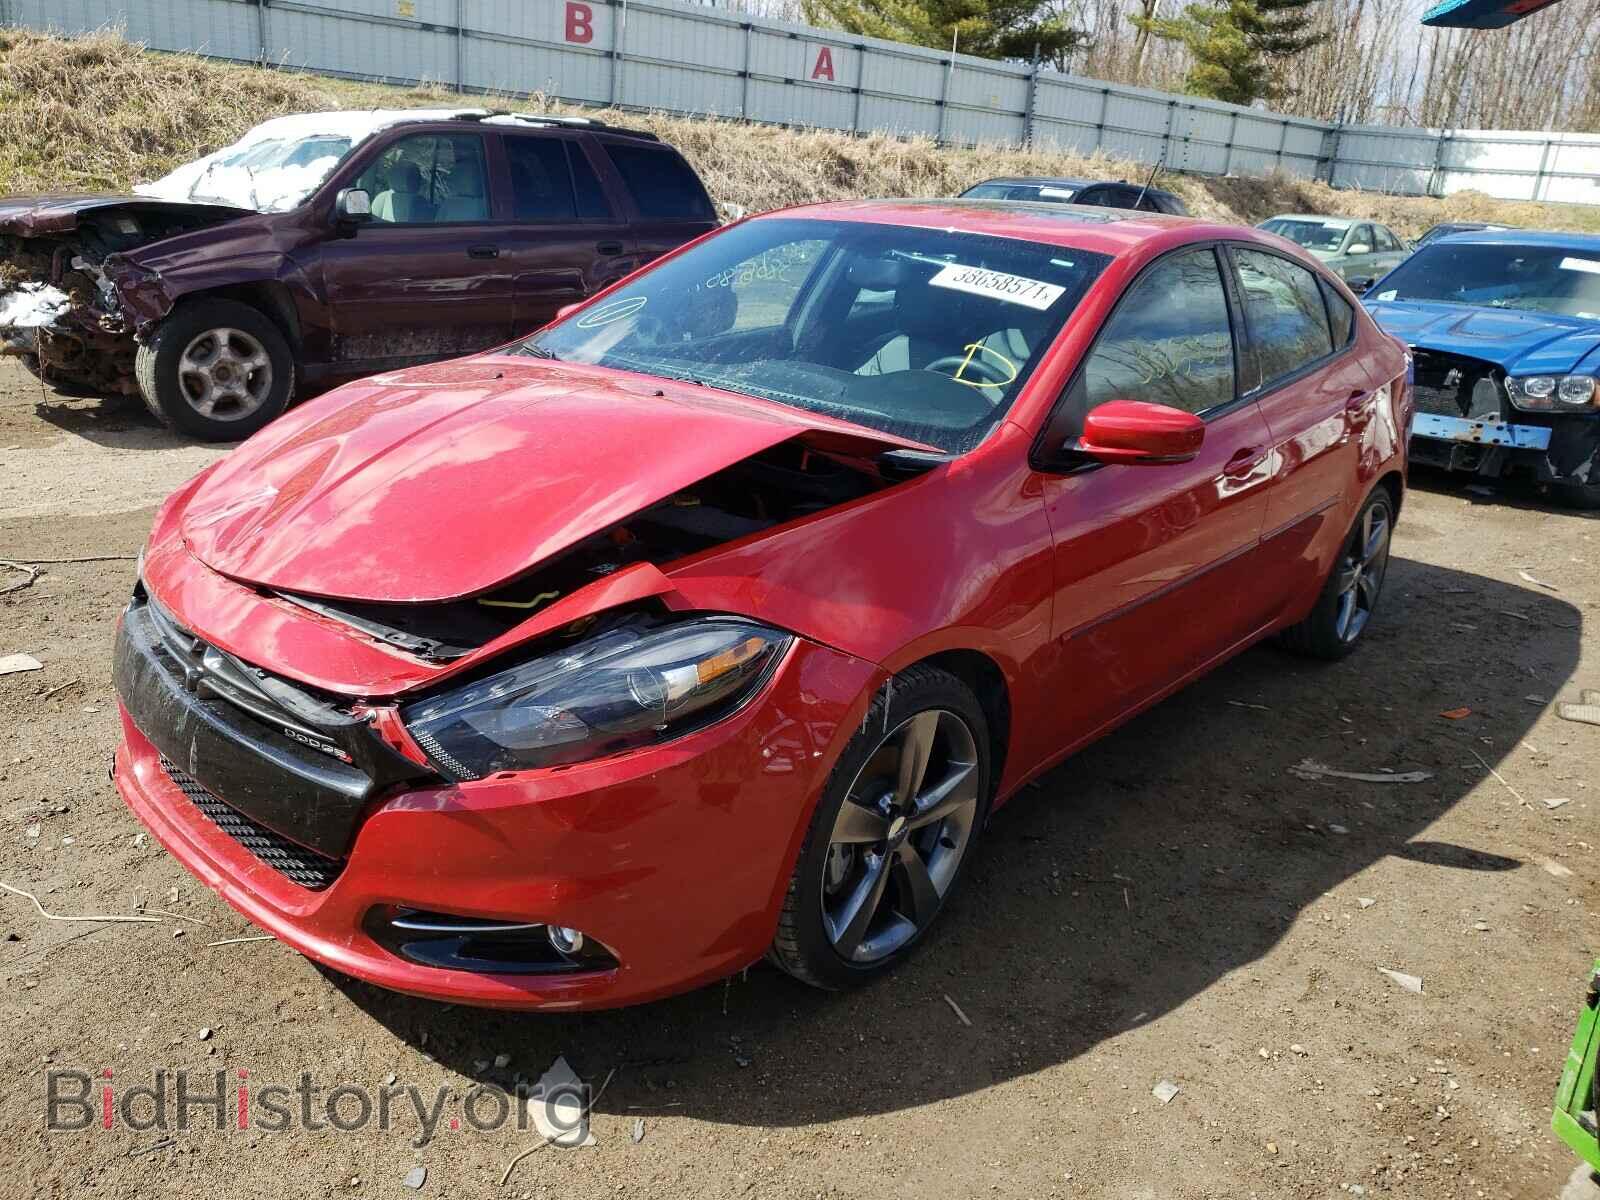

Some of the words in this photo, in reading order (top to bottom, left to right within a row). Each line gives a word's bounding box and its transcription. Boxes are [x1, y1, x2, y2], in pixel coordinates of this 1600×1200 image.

[565, 1, 594, 44] B
[811, 46, 835, 81] A
[283, 727, 347, 758] DODGE
